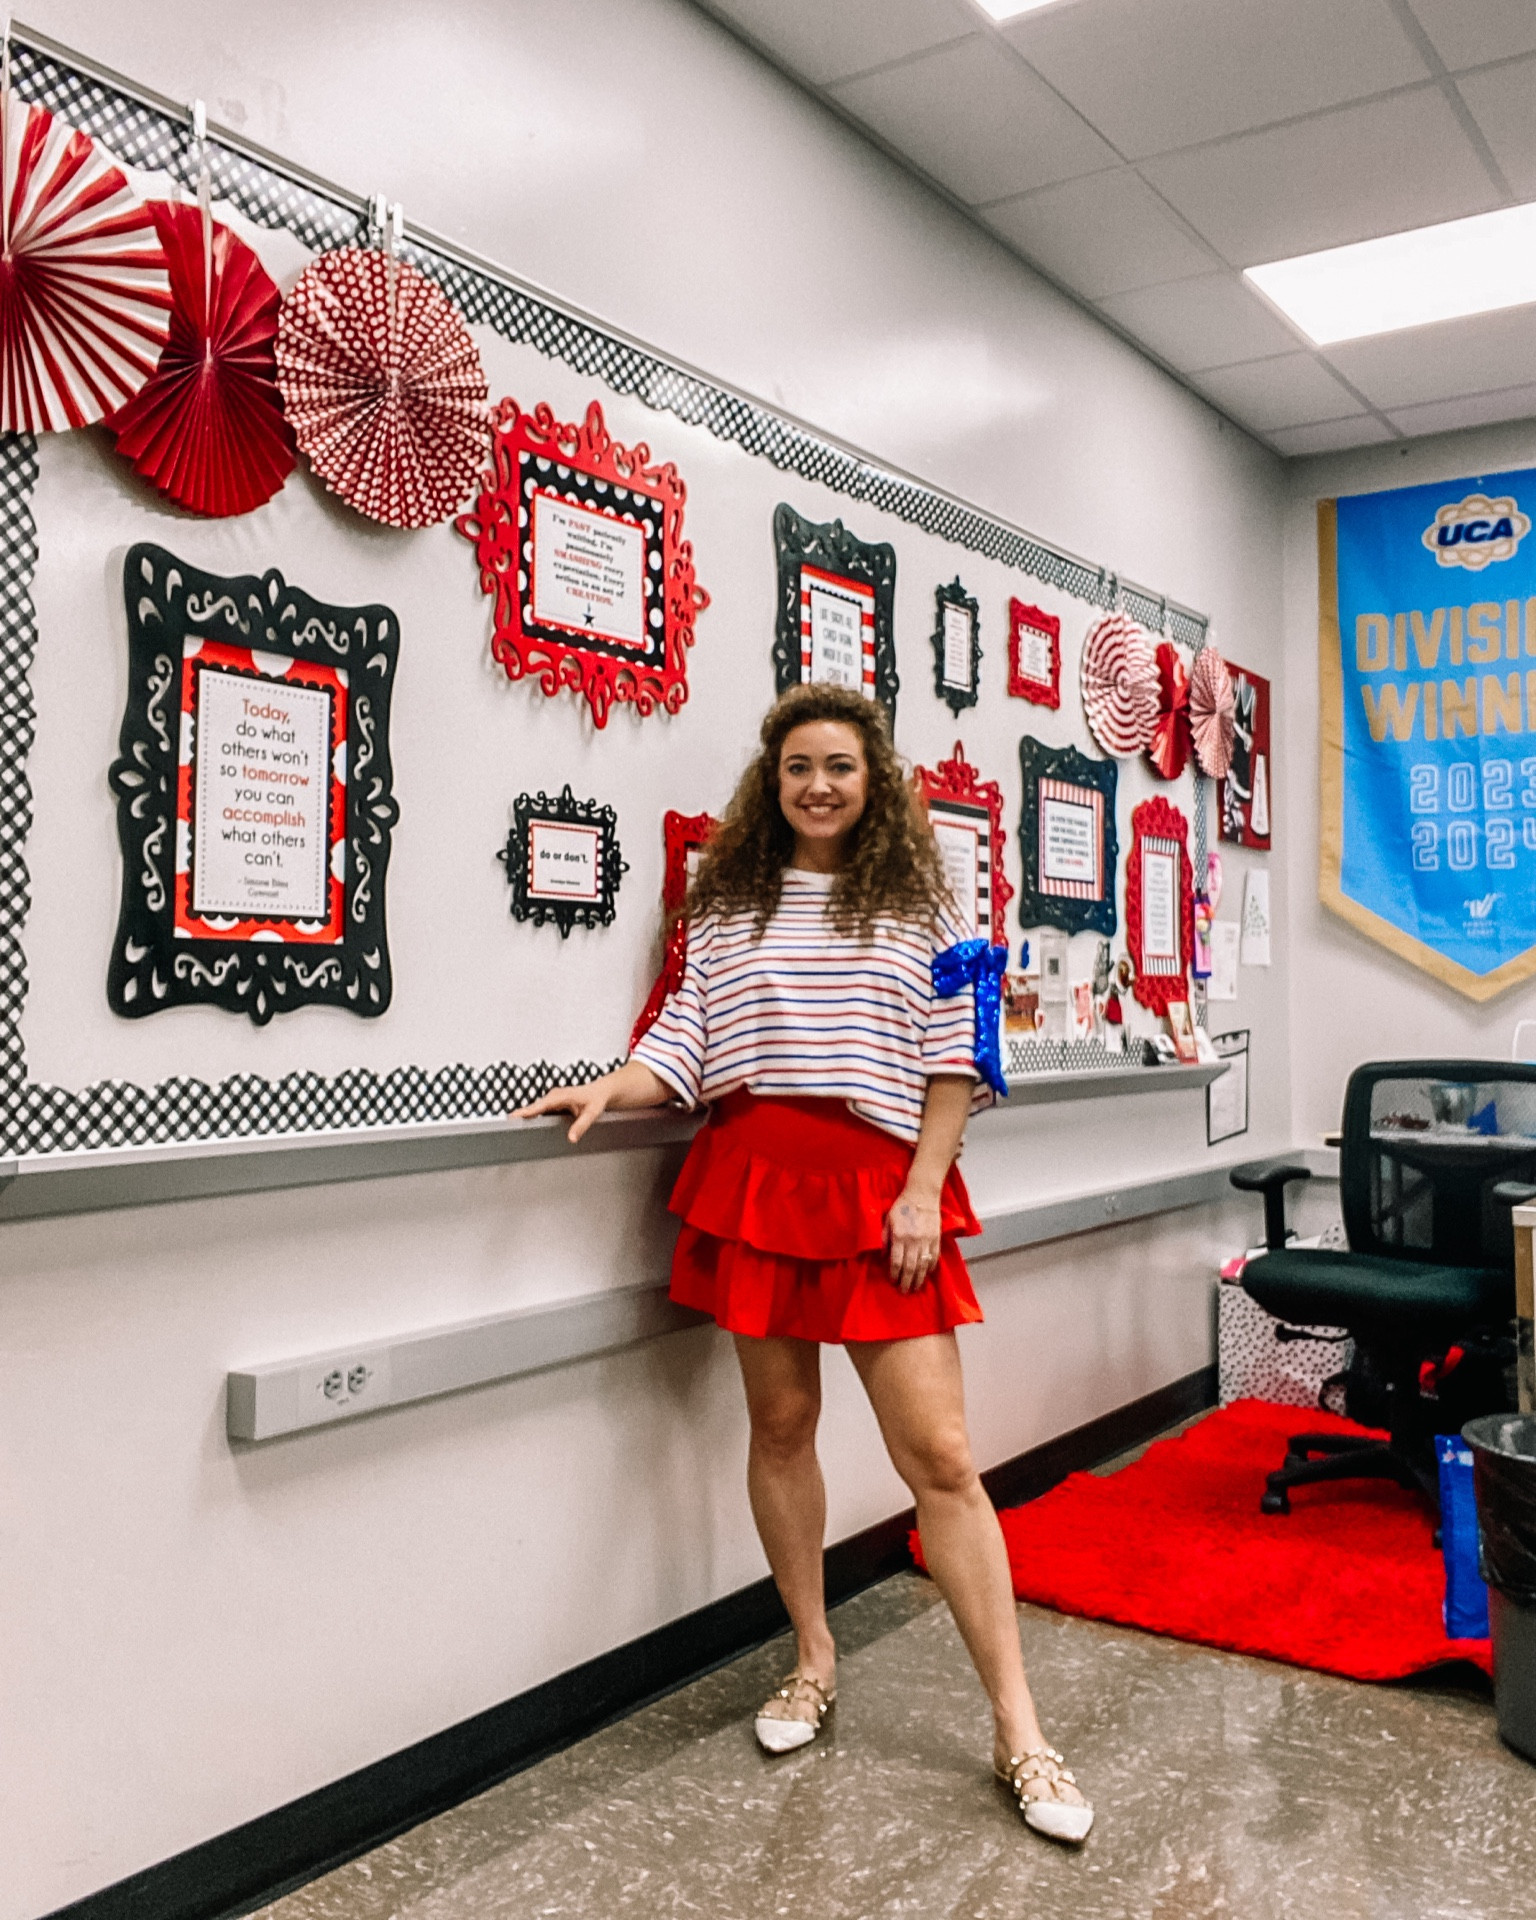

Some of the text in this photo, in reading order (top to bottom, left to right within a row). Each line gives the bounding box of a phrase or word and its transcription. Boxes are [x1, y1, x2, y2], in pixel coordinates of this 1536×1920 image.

[1438, 517, 1513, 547] UCA
[242, 698, 291, 724] Today,
[1361, 670, 1536, 742] WINN
[236, 721, 295, 743] do what
[221, 742, 309, 766] others won't
[220, 764, 310, 787] so tomorrow
[1410, 757, 1536, 814] 2023
[235, 788, 295, 806] you can
[223, 806, 306, 828] accomplish
[221, 826, 306, 848] what others
[245, 850, 284, 868] can't.
[540, 849, 551, 860] do
[553, 852, 562, 860] or
